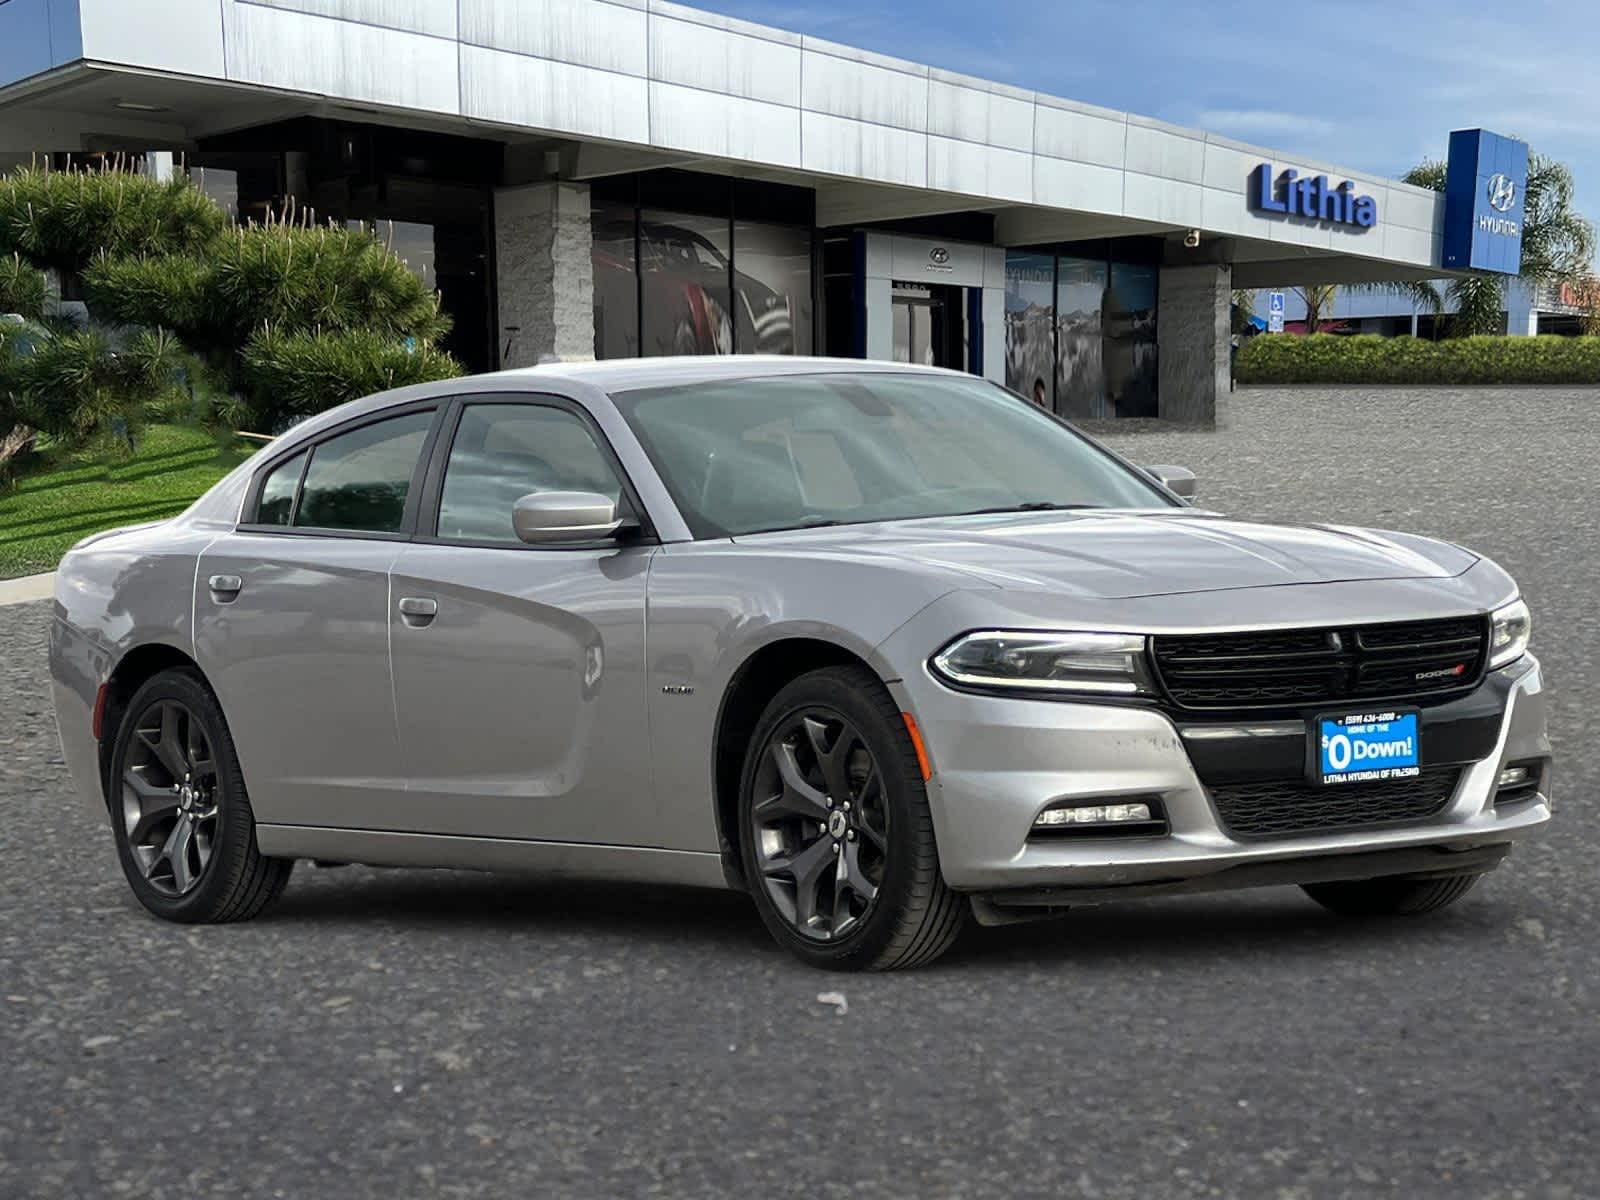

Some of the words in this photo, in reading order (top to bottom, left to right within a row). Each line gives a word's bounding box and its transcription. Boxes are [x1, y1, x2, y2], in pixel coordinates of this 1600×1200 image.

[1248, 163, 1377, 228] Lithia
[1479, 215, 1521, 237] HYUNDAI
[1366, 725, 1375, 734] OF
[1377, 723, 1389, 732] THE
[1353, 736, 1412, 760] Down!
[1347, 770, 1379, 782] HYUNDAI
[1380, 769, 1390, 779] OF
